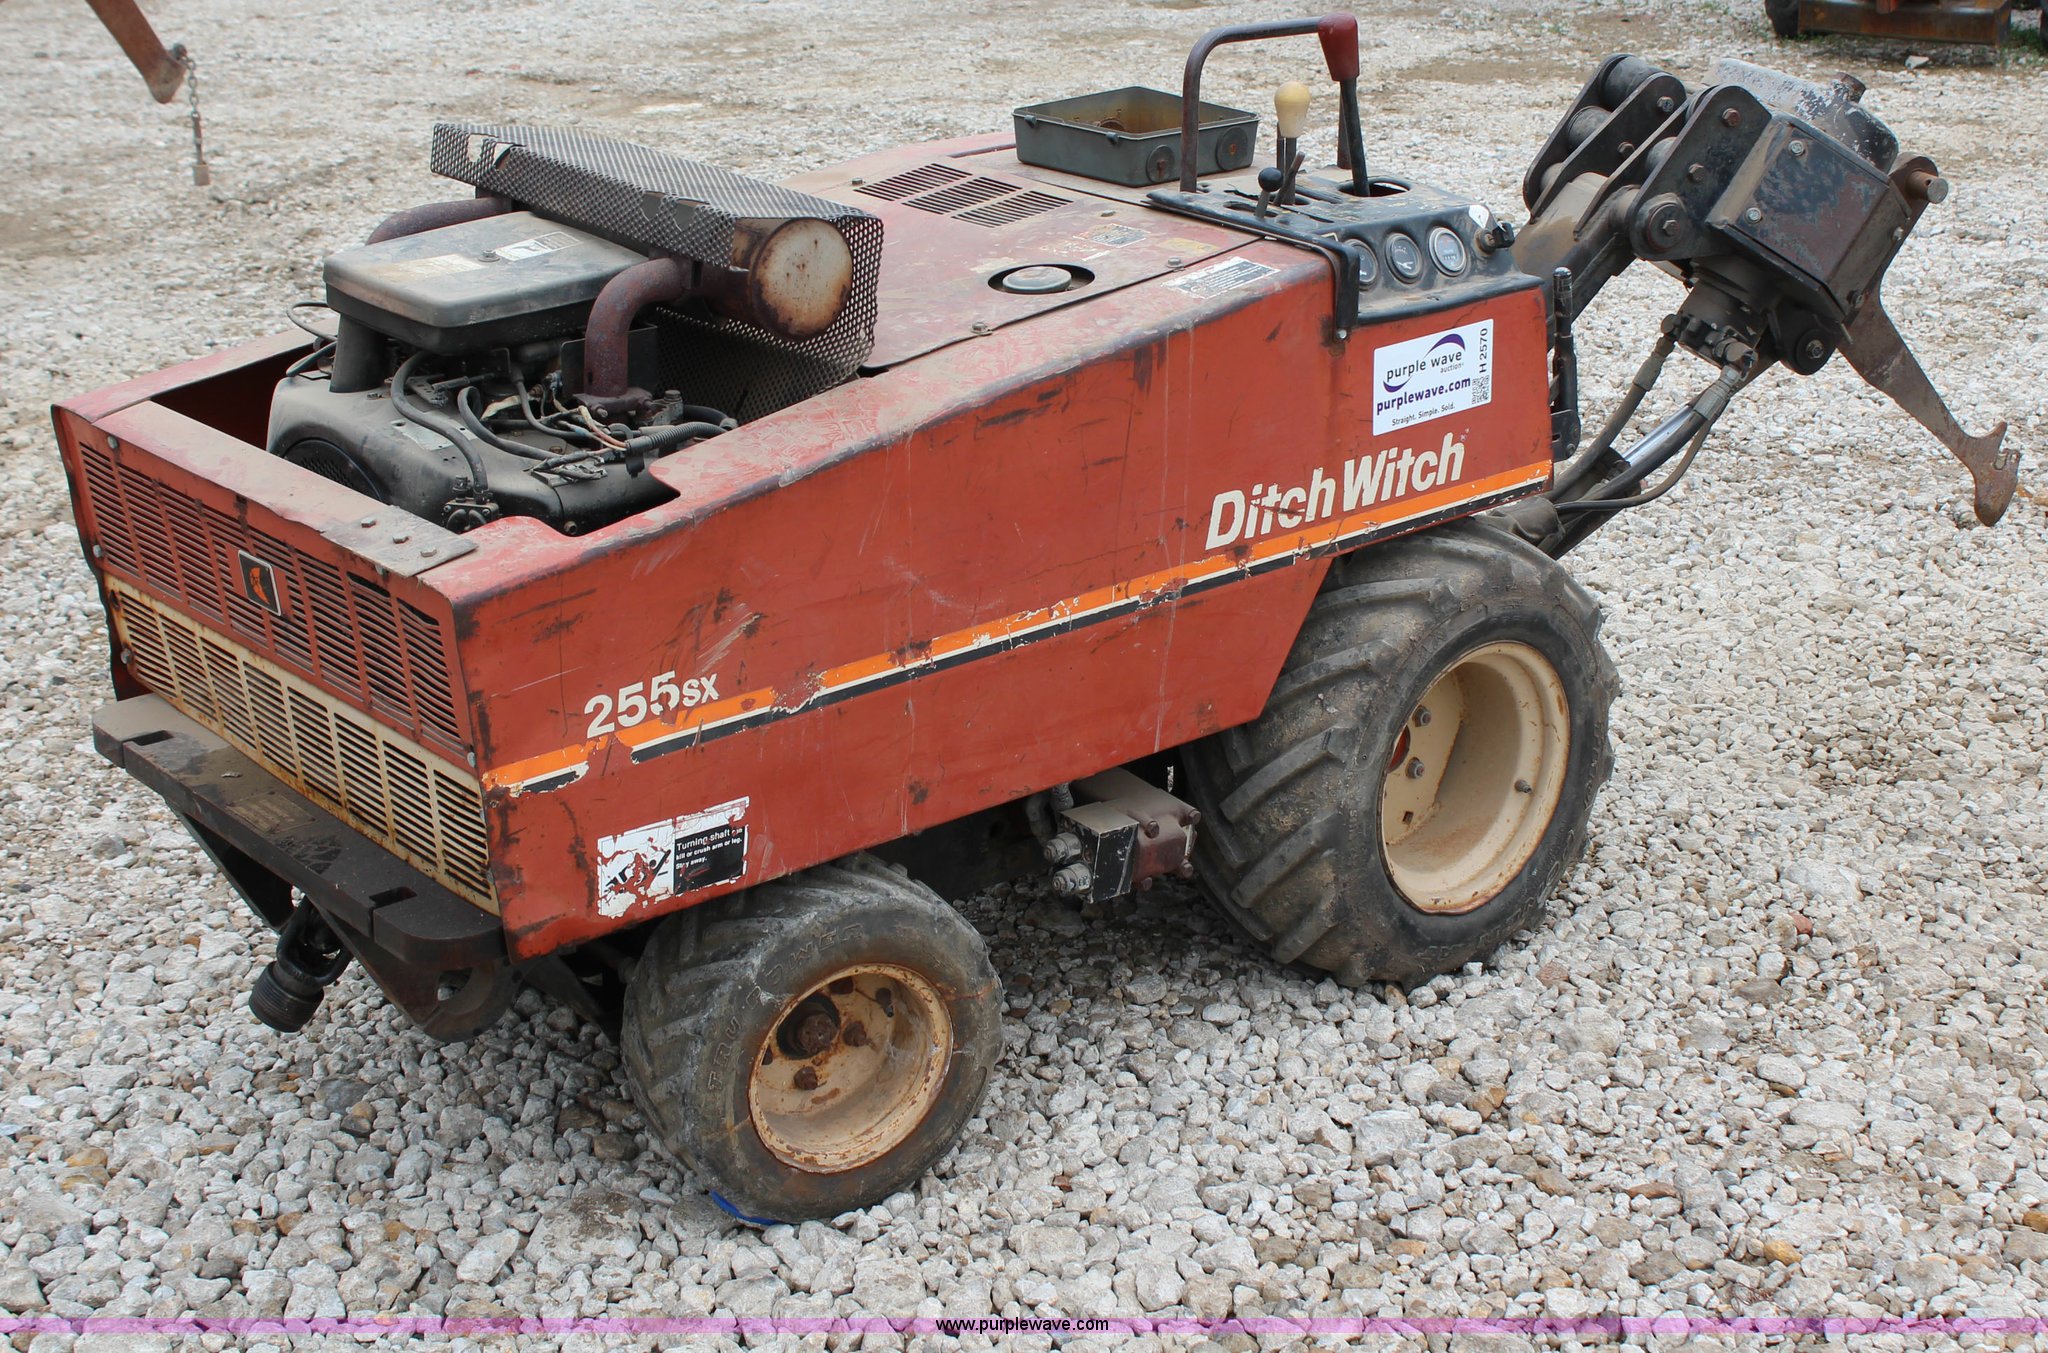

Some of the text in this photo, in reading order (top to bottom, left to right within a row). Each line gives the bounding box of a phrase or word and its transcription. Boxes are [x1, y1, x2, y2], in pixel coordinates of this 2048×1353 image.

[1387, 351, 1462, 382] purple wave
[1376, 377, 1471, 415] purplewave.com
[1392, 402, 1456, 426] Straight. Simple. Sold.
[1205, 432, 1465, 550] Ditch Witch
[677, 836, 708, 850] Turning
[710, 829, 730, 841] shaft
